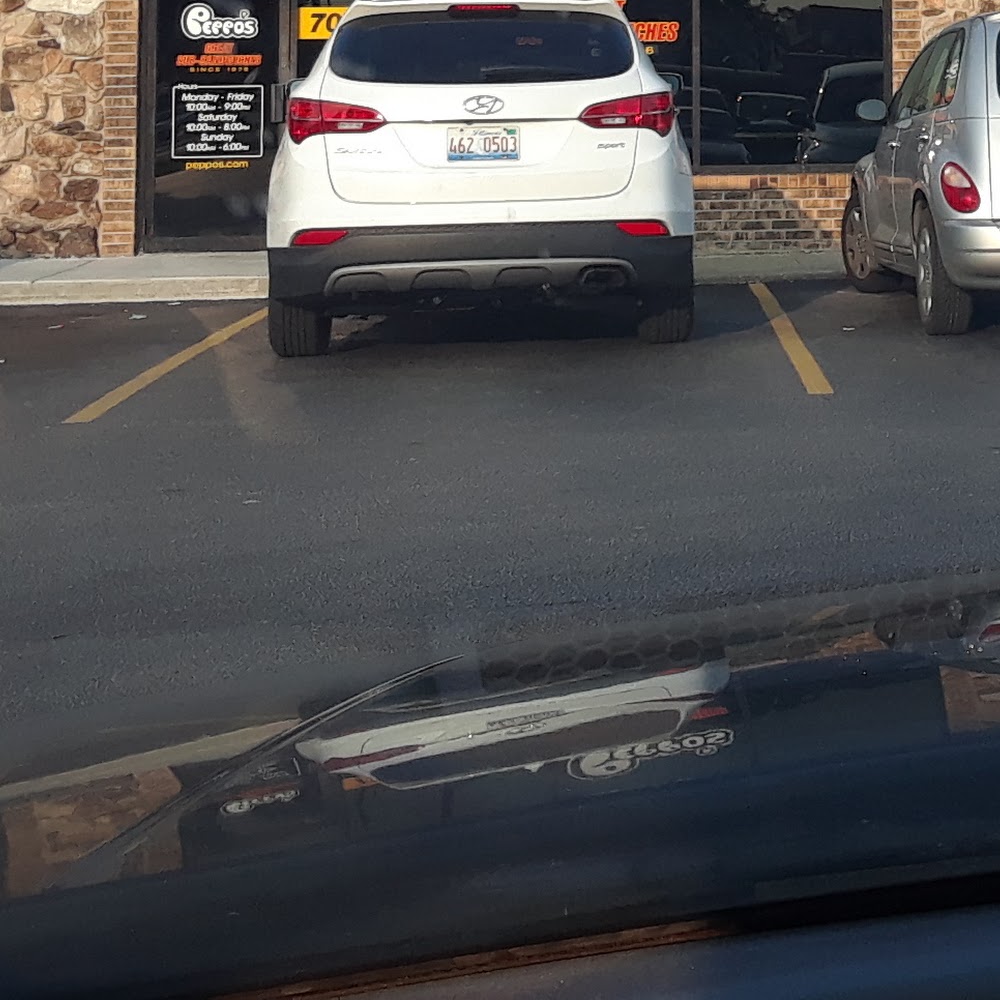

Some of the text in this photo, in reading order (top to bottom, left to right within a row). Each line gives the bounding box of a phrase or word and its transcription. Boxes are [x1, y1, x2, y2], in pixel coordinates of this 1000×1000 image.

[181, 92, 219, 102] Monday
[226, 92, 254, 102] Friday
[197, 113, 238, 122] Saturday
[200, 133, 234, 142] Sunday
[449, 136, 517, 154] 462 0503
